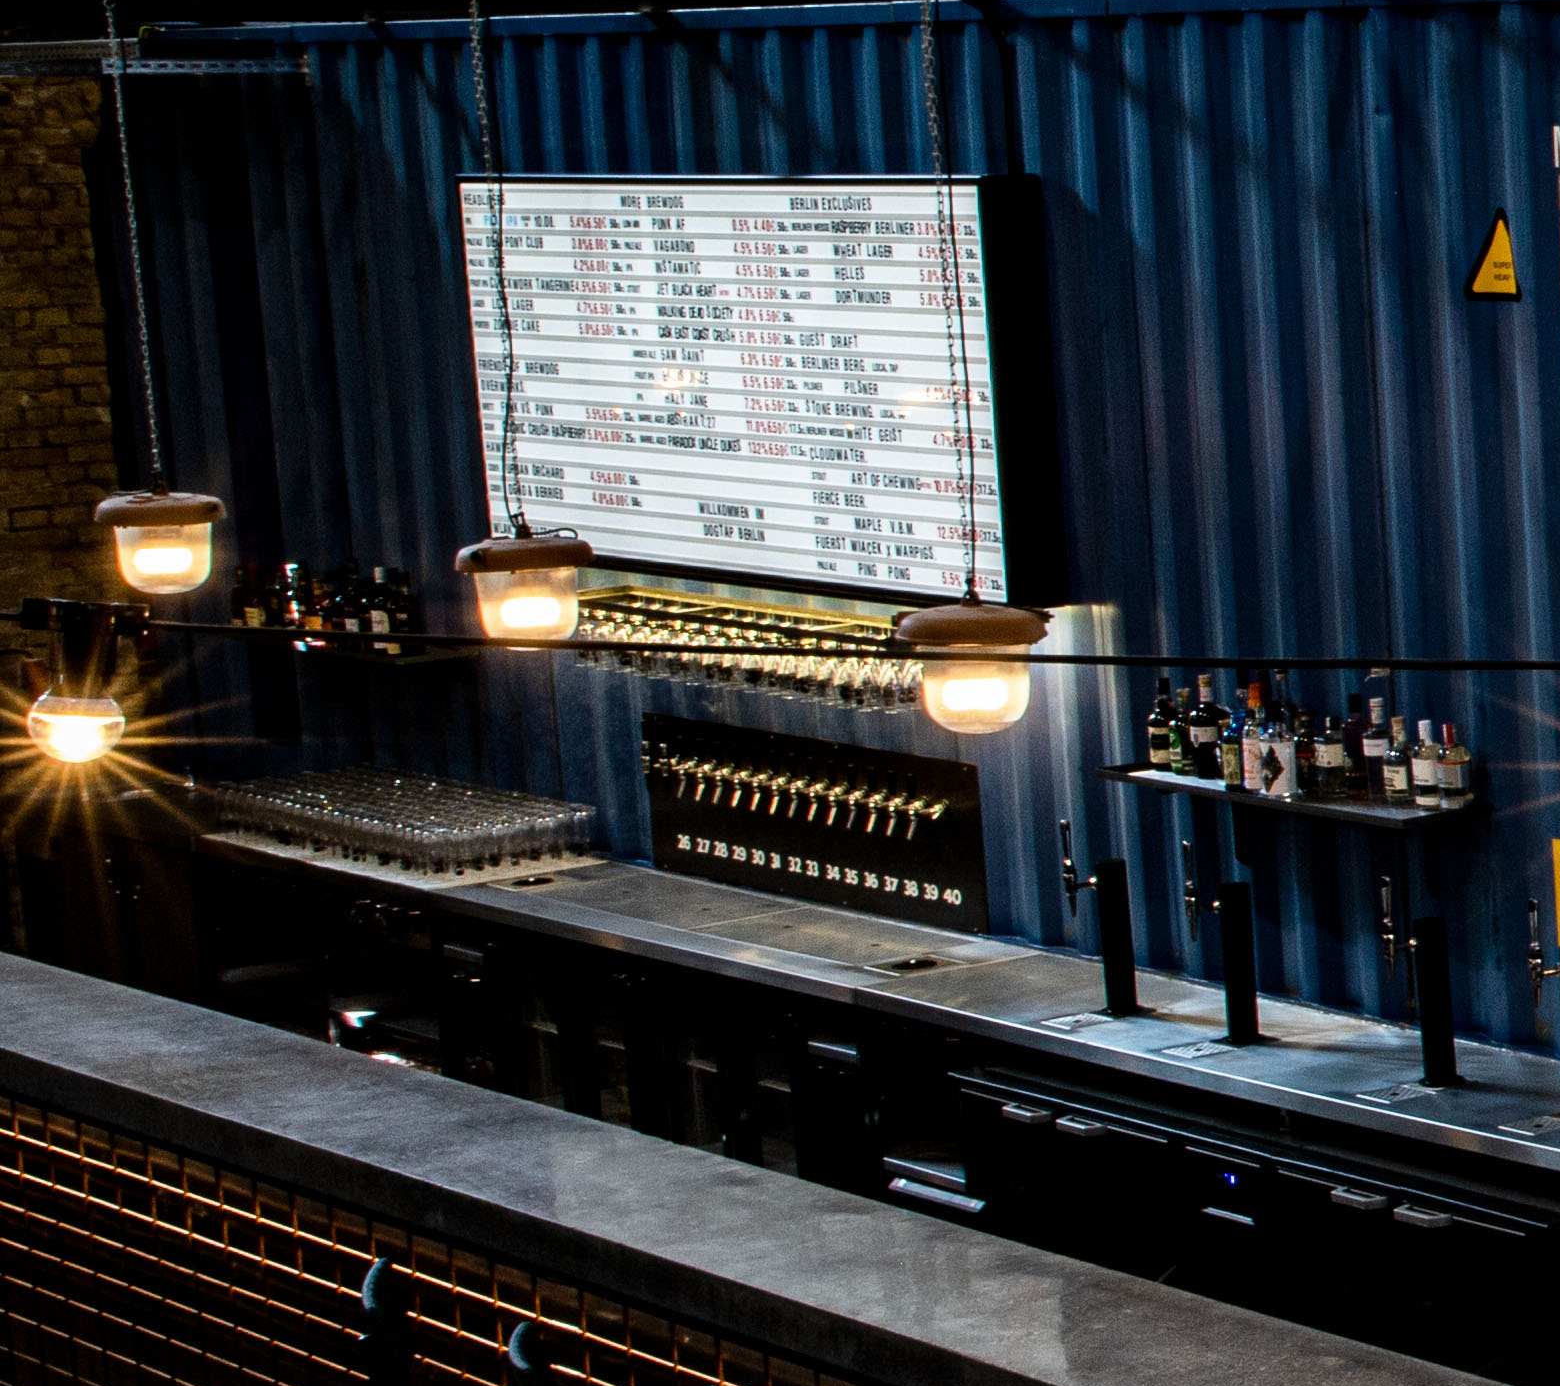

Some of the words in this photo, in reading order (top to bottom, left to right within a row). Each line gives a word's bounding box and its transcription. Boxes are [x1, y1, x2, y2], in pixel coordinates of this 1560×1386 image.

[619, 195, 641, 208] MORE
[646, 196, 683, 208] BREWDOG
[789, 197, 818, 210] BERLIN
[821, 197, 871, 210] EXCLUSIVES
[651, 218, 671, 229] PUNK
[875, 221, 915, 234] BERLINER
[653, 239, 695, 252] VAGABOND
[832, 243, 861, 257] WHEAT
[866, 244, 893, 257] LAGER
[834, 266, 864, 280] HELLES
[489, 277, 532, 289] CLCKWORK
[835, 289, 891, 304] DORTMUNDER
[799, 332, 825, 347] GUEST
[830, 334, 858, 348] DRAFT
[525, 362, 559, 374] BREWDOG
[801, 356, 839, 370] BERLINER
[843, 380, 879, 395] PILSNER
[690, 394, 708, 407] JANE
[878, 428, 903, 443] GEIST
[850, 471, 867, 486] ART
[882, 474, 921, 491] CHEWING
[812, 490, 840, 505] FIERCE
[854, 517, 882, 532] MAPLE
[815, 533, 846, 550] FUERST
[857, 562, 877, 576] PING
[887, 565, 910, 580] PONG
[677, 834, 691, 850] 26
[696, 838, 710, 854] 27
[714, 841, 728, 858] 28
[732, 845, 747, 861] 29
[752, 849, 765, 865] 30
[770, 852, 781, 869] 31
[788, 856, 802, 873] 32
[806, 860, 819, 877] 33
[826, 864, 840, 881] 34
[844, 868, 858, 885] 35
[864, 872, 878, 889] 36
[884, 875, 898, 891] 37
[904, 880, 918, 897] 38
[924, 883, 938, 900] 39
[943, 888, 962, 905] 40
